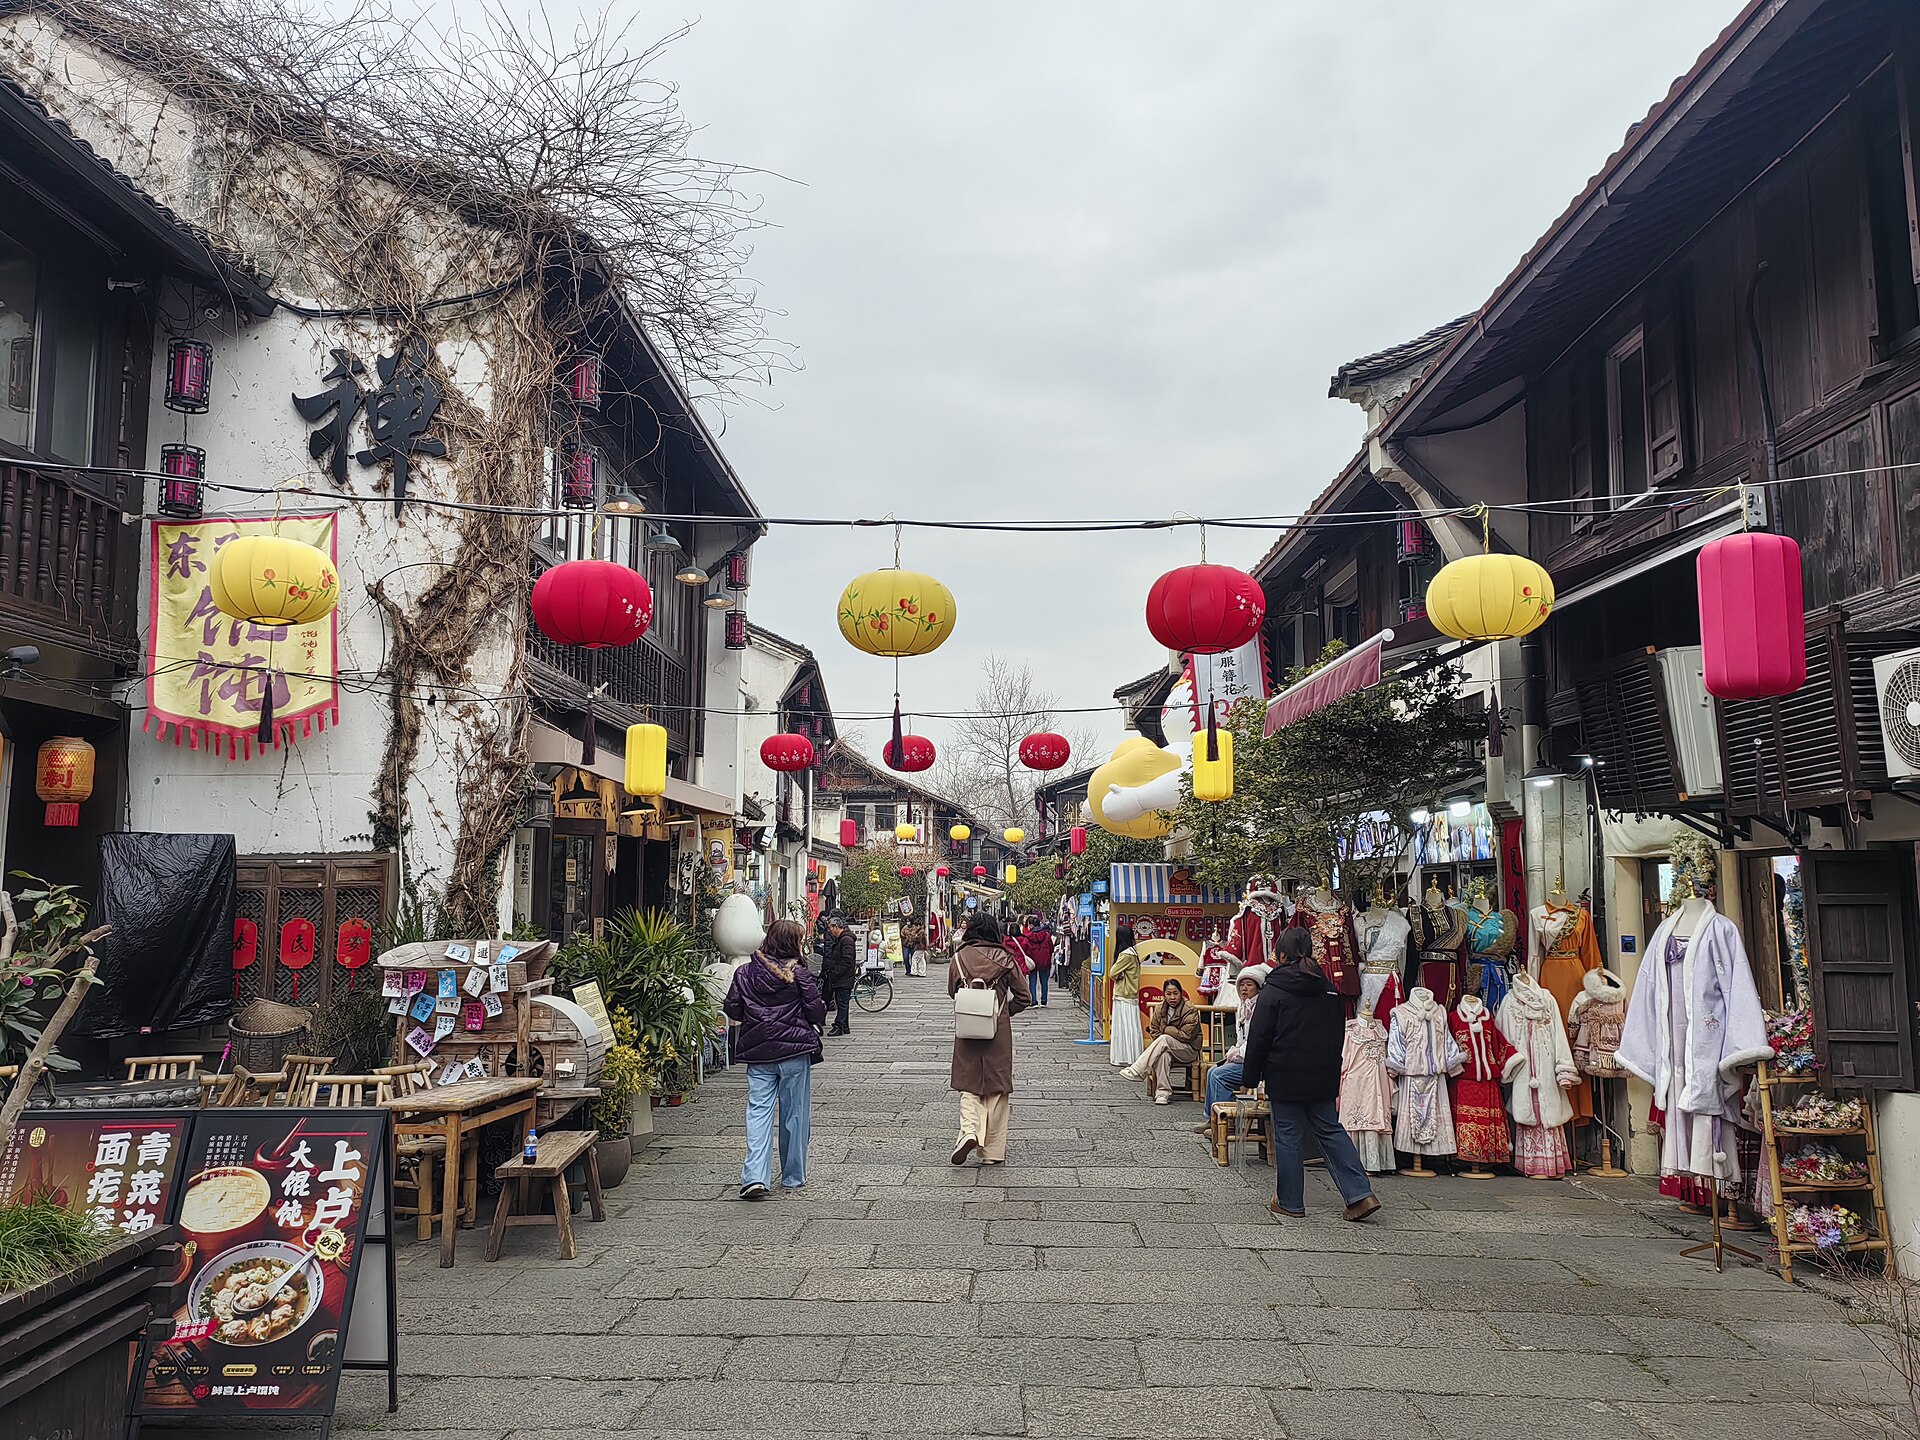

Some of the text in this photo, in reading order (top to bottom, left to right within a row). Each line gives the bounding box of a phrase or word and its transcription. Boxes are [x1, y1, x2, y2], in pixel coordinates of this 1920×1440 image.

[1219, 649, 1238, 696] 服簪花
[291, 934, 309, 954] 民
[341, 932, 364, 953] 安
[275, 1139, 315, 1228] 大馄饨
[308, 1139, 362, 1231] 上卢
[319, 1235, 341, 1254] 必点
